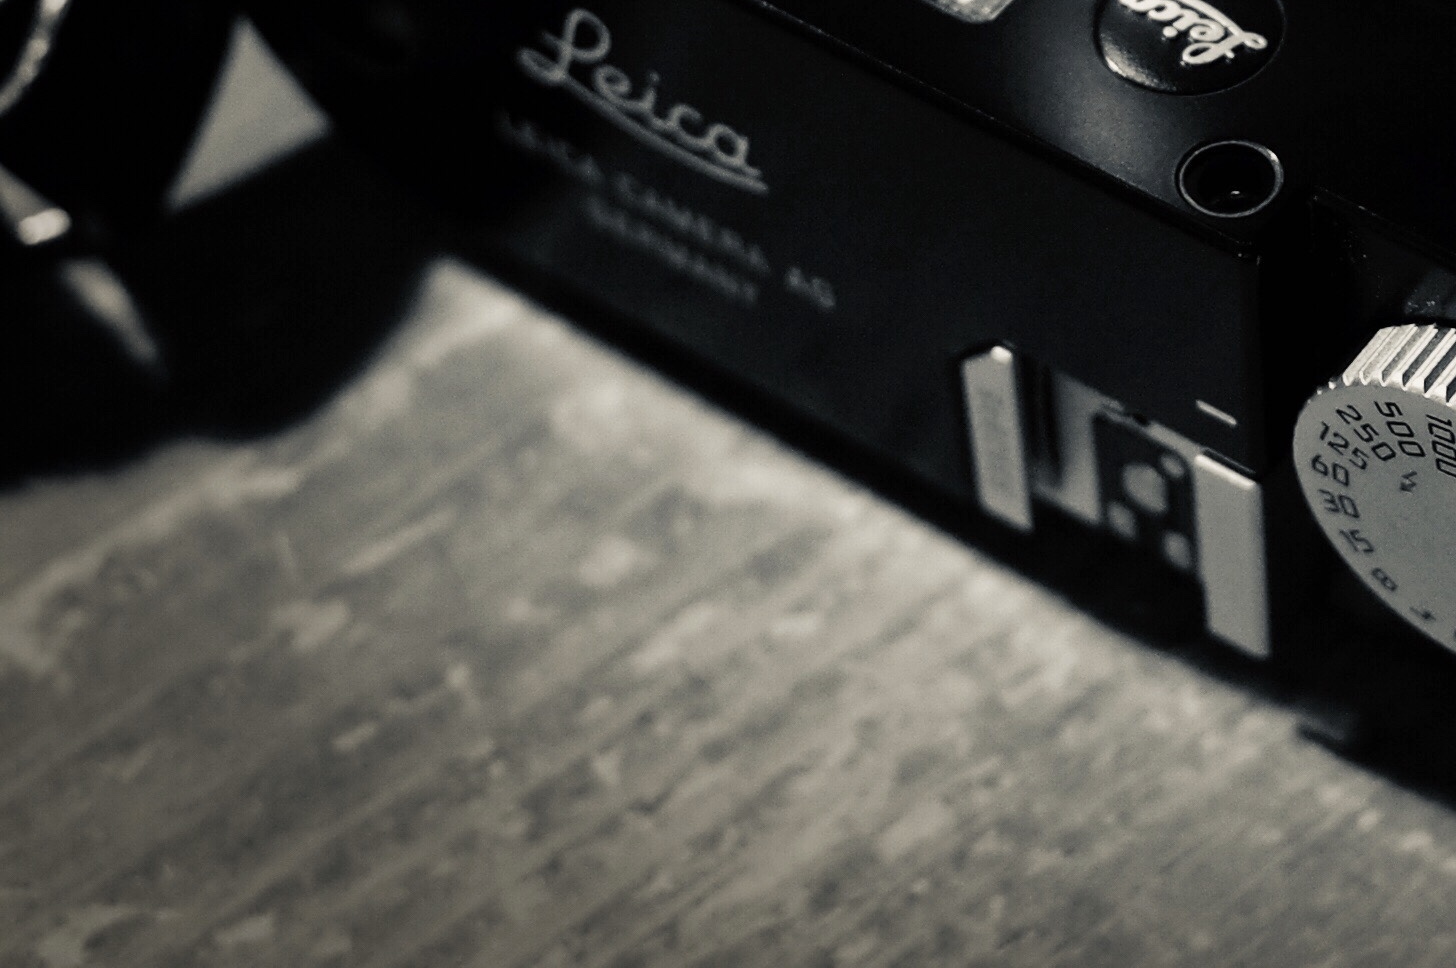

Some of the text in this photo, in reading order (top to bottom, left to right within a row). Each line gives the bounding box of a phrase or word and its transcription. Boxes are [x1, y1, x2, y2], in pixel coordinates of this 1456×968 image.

[515, 6, 770, 196] Leica
[1316, 422, 1367, 471] 125
[1336, 404, 1397, 462] 250
[1374, 400, 1426, 458] 500
[1311, 454, 1350, 487] 60
[1318, 490, 1360, 519] 30
[1338, 529, 1374, 554] 15
[1370, 568, 1398, 593] 8
